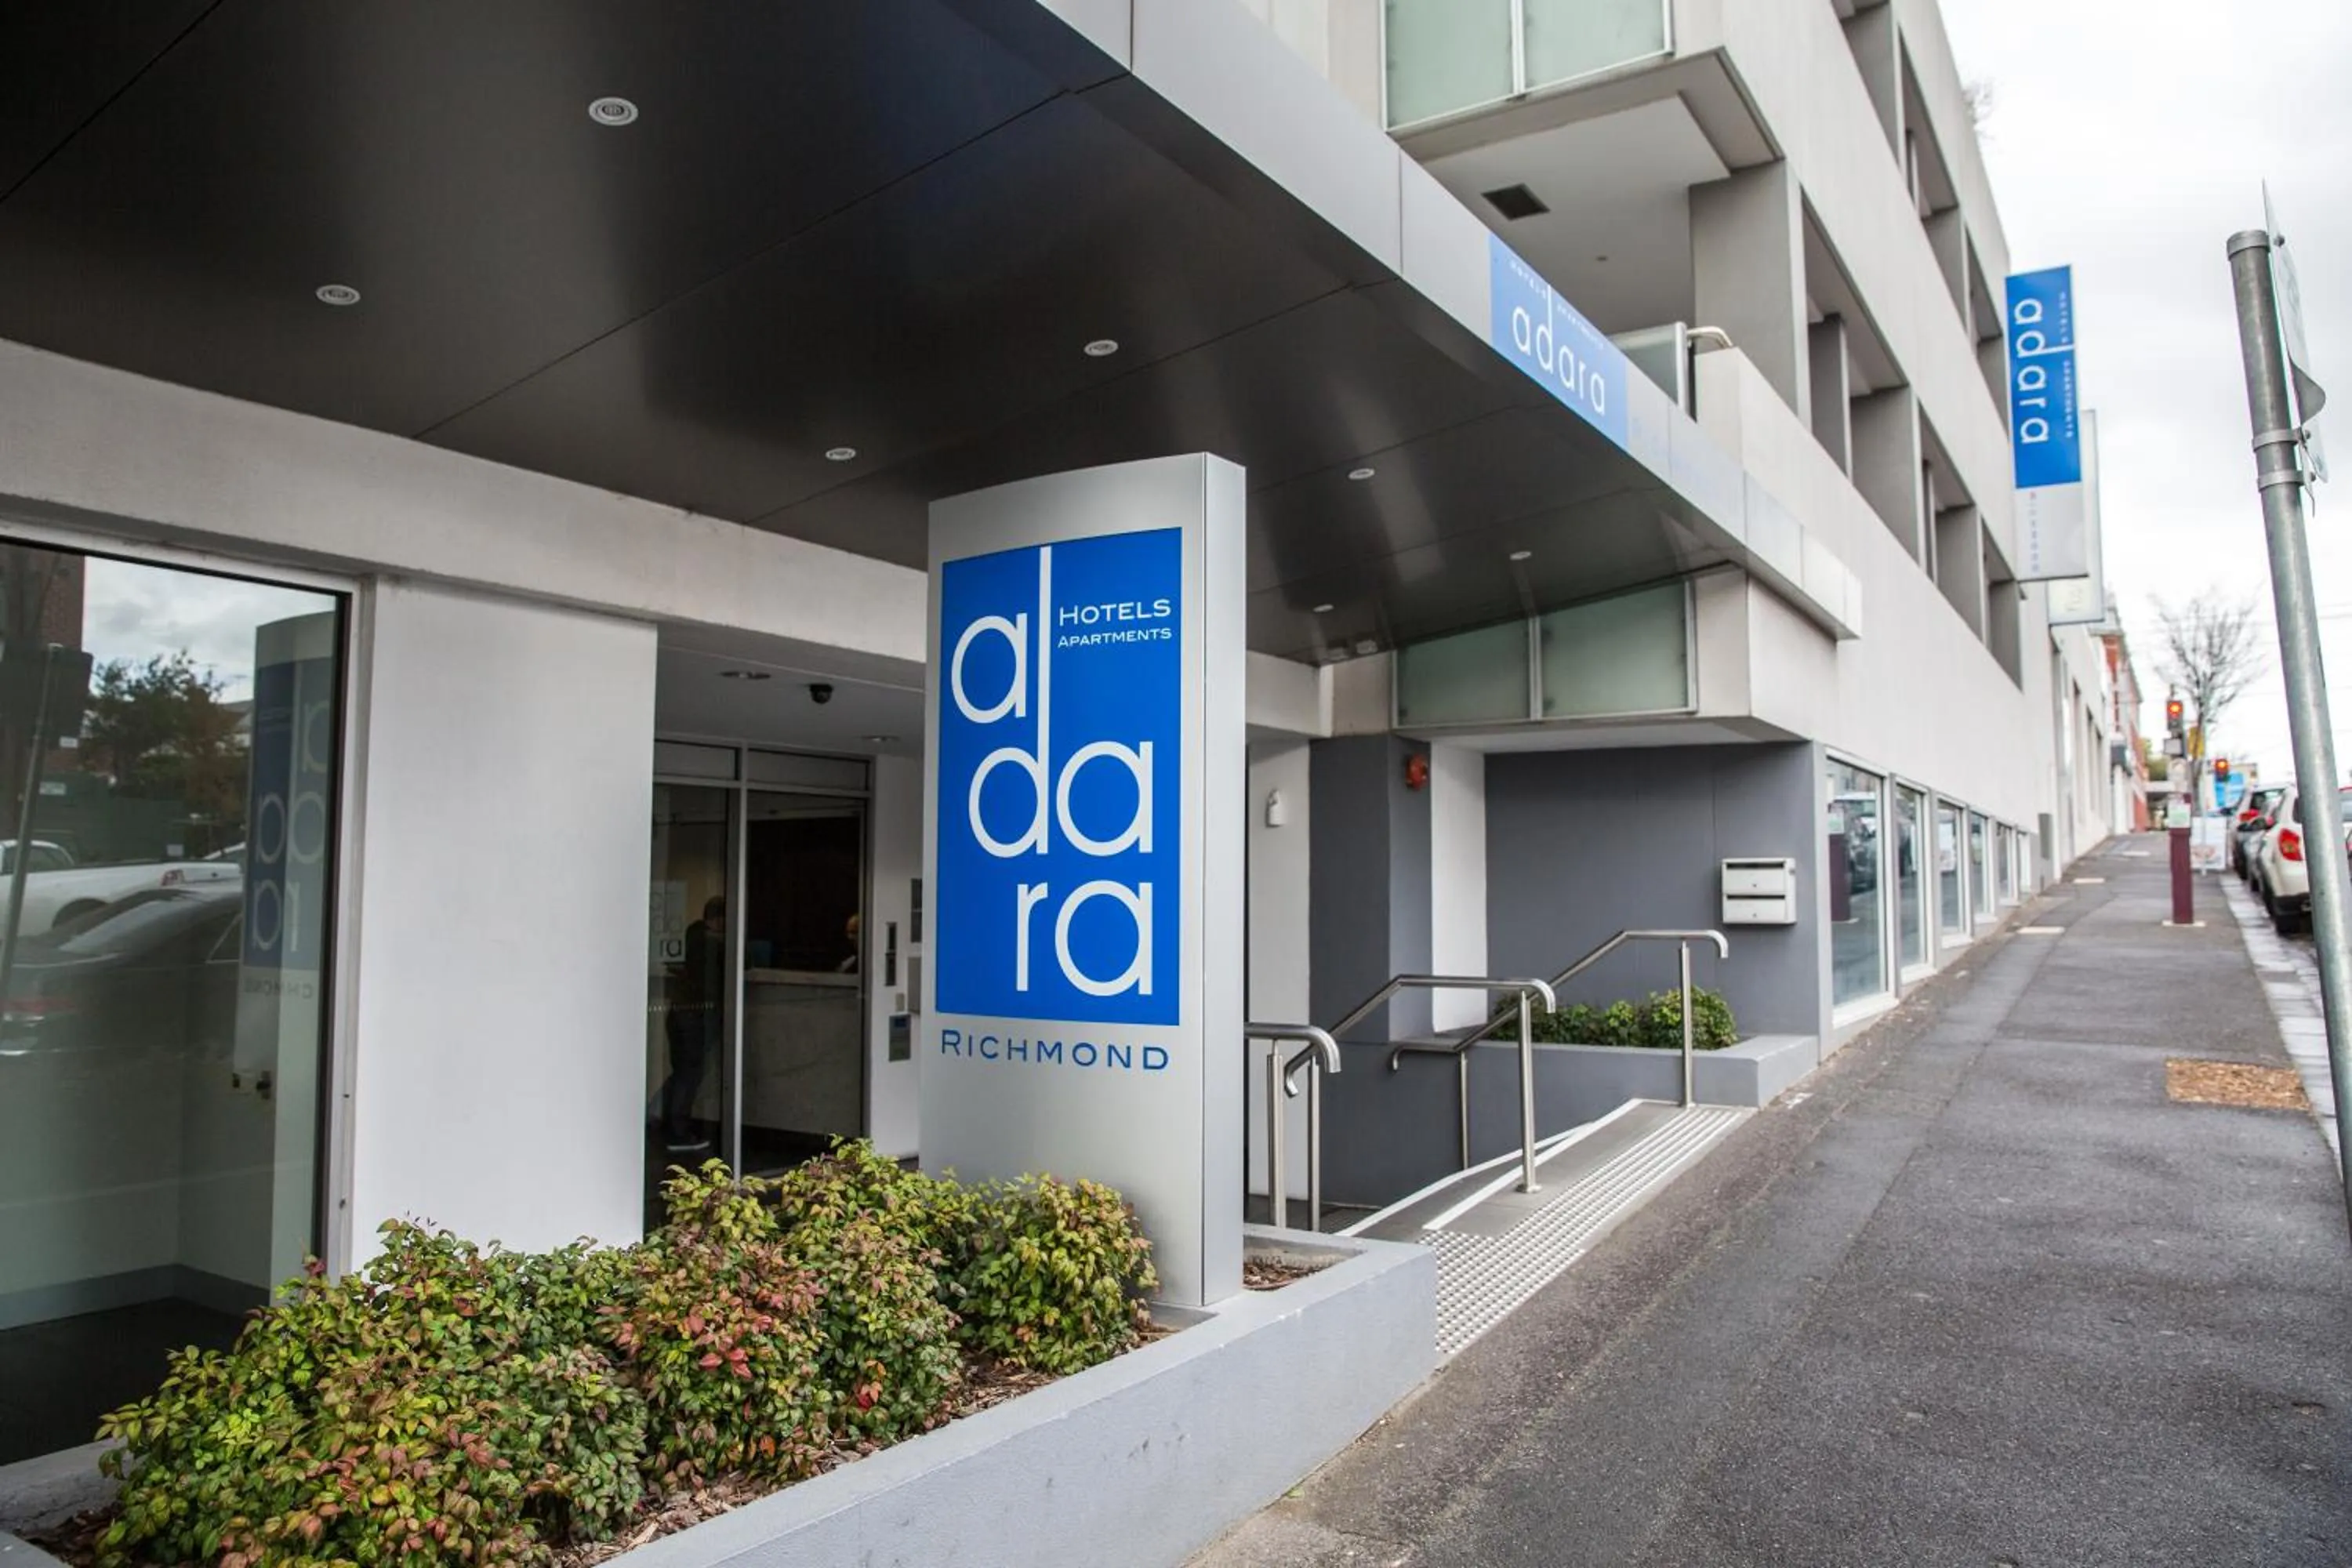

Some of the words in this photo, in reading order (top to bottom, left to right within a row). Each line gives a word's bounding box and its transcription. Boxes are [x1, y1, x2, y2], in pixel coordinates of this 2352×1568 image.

[1512, 284, 1606, 416] adara
[2013, 298, 2074, 445] adara
[1059, 598, 1172, 626] HOTELS
[1058, 627, 1172, 648] APARTMENTS
[941, 1029, 1170, 1071] RICHMOND
